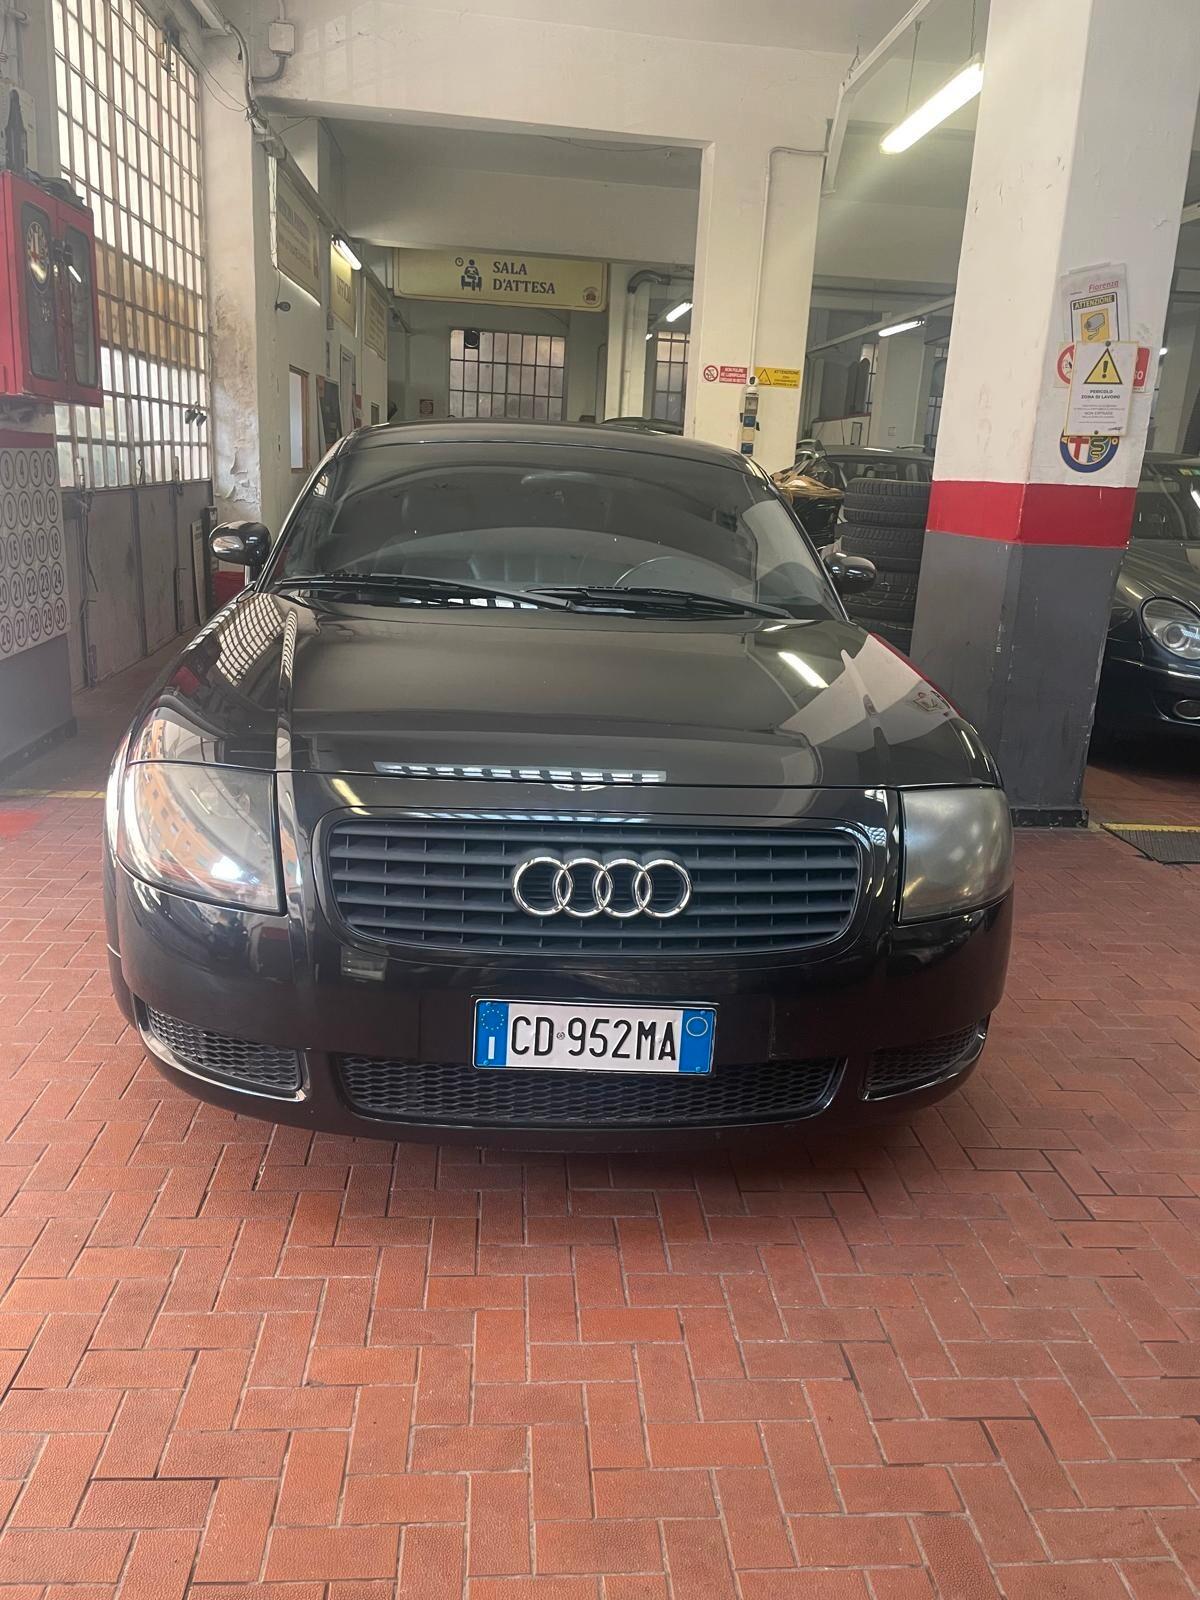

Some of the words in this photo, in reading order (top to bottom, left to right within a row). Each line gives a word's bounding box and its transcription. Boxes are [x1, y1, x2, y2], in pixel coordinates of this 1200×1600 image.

[492, 261, 528, 276] SALA
[492, 278, 556, 294] D'ATTESA
[1074, 295, 1114, 310] ATTENZIONE
[49, 496, 56, 516] 12
[9, 540, 18, 561] 15
[24, 538, 32, 558] 16
[38, 536, 45, 555] 17
[51, 533, 59, 552] 18
[13, 580, 21, 601] 21
[27, 576, 36, 597] 22
[41, 572, 49, 592] 23
[54, 569, 62, 589] 24
[1, 622, 11, 645] 26
[16, 618, 25, 639] 27
[30, 613, 39, 634] 28
[44, 609, 52, 629] 29
[56, 604, 64, 624] 30
[487, 1036, 496, 1060] I
[511, 1016, 555, 1056] CD
[567, 1017, 677, 1061] 952MA
